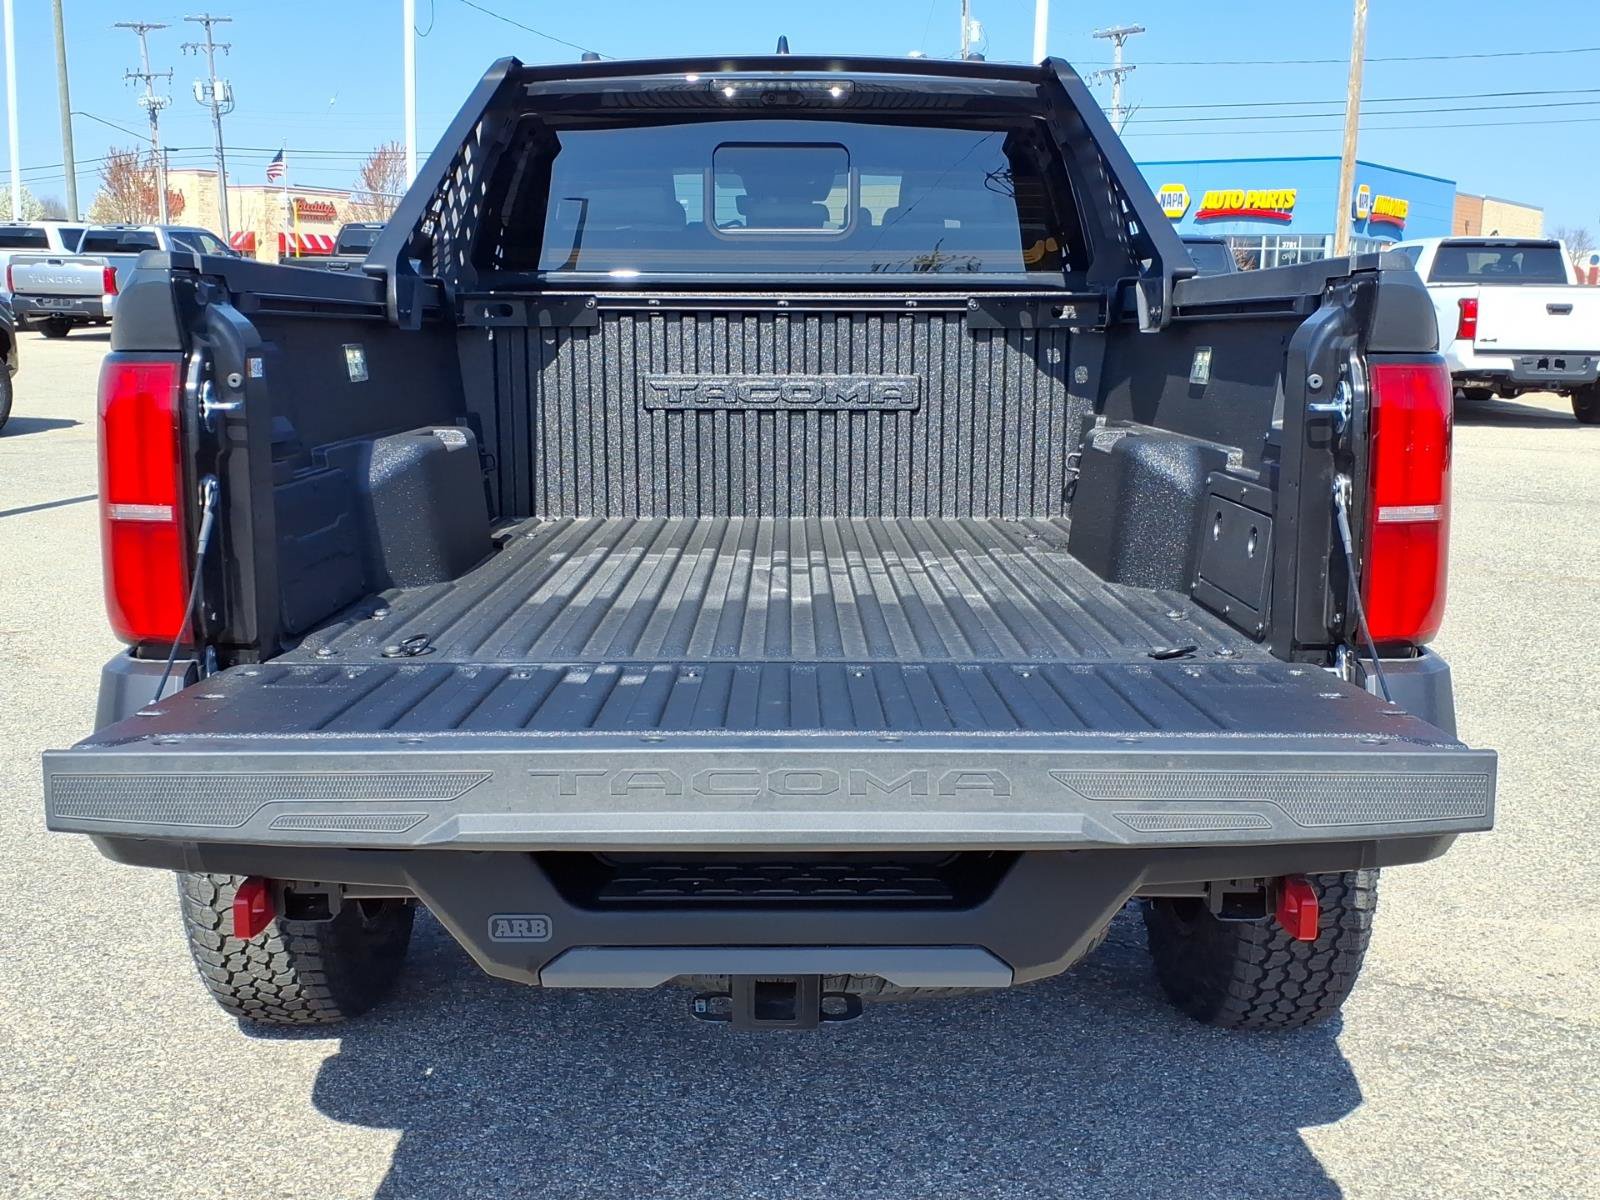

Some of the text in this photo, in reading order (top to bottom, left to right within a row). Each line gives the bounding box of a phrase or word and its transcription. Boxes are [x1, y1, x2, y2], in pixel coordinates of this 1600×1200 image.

[1160, 193, 1183, 207] NAPA
[1201, 189, 1296, 209] AUTO PARTS
[28, 274, 82, 284] TUNDRA
[649, 380, 915, 404] TACOMA
[528, 769, 1012, 796] TACOMA
[495, 919, 547, 937] ARB
